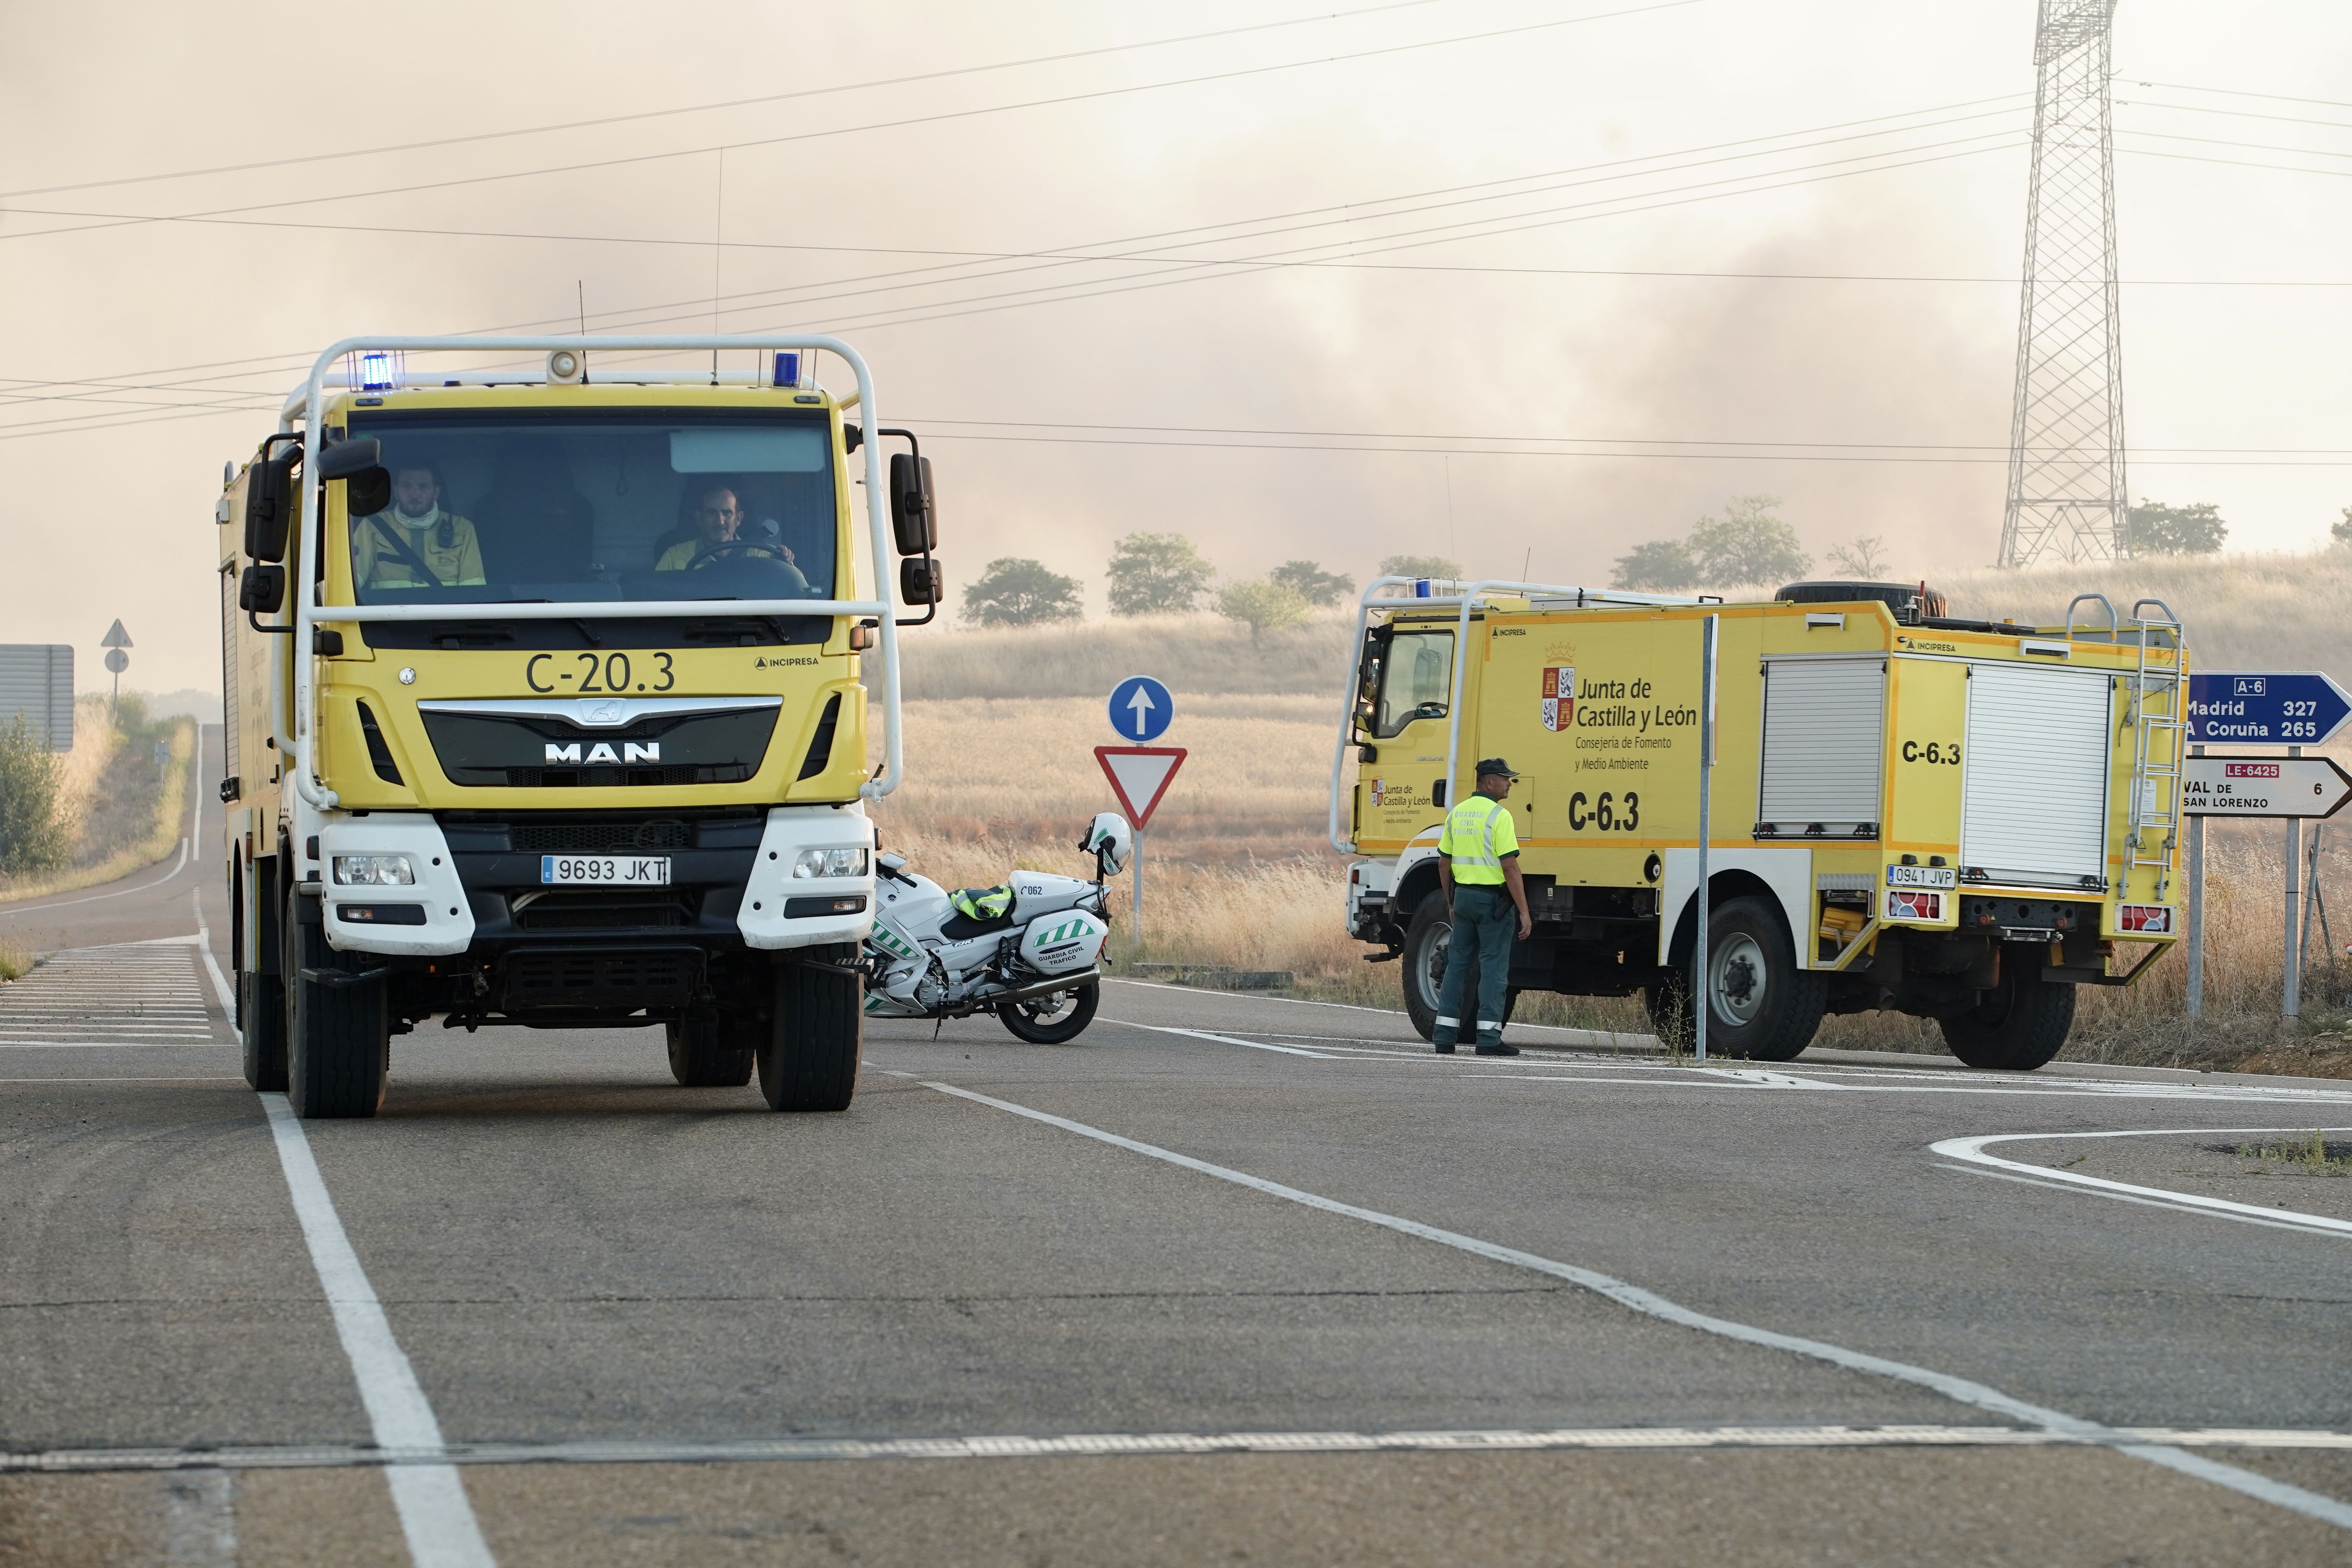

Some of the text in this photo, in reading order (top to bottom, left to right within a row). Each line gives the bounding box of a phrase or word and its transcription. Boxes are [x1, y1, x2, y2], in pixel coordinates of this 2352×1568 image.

[1917, 642, 1956, 652] INCIPRESA
[770, 657, 819, 667] INCIPRESA
[526, 652, 674, 693] C-20.3
[1578, 678, 1651, 699] Junta de
[2237, 681, 2263, 693] A-6
[2187, 701, 2316, 716] Madrid 327
[1577, 704, 1696, 733] Castilla y León
[2186, 721, 2316, 737] A Coruña 265
[1576, 736, 1671, 751] Consejería de Fomento
[545, 742, 659, 765] MAN
[1903, 741, 1960, 765] C-6.3
[1575, 757, 1649, 772] y Medio Ambiente
[2227, 766, 2278, 776] LE-6425
[1384, 785, 1412, 794] Junta de
[2185, 782, 2322, 795] VAL DE 6
[1384, 796, 1430, 808] Castilla y León
[2183, 798, 2268, 808] SAN LORENZO
[1569, 792, 1638, 831] C-6.3
[559, 860, 665, 880] 9693 JKT
[1897, 868, 1951, 884] 0941 JVP
[1028, 886, 1042, 895] 062
[1038, 946, 1084, 961] GUARDIA CIVIL
[1049, 955, 1076, 965] TRAFICO
